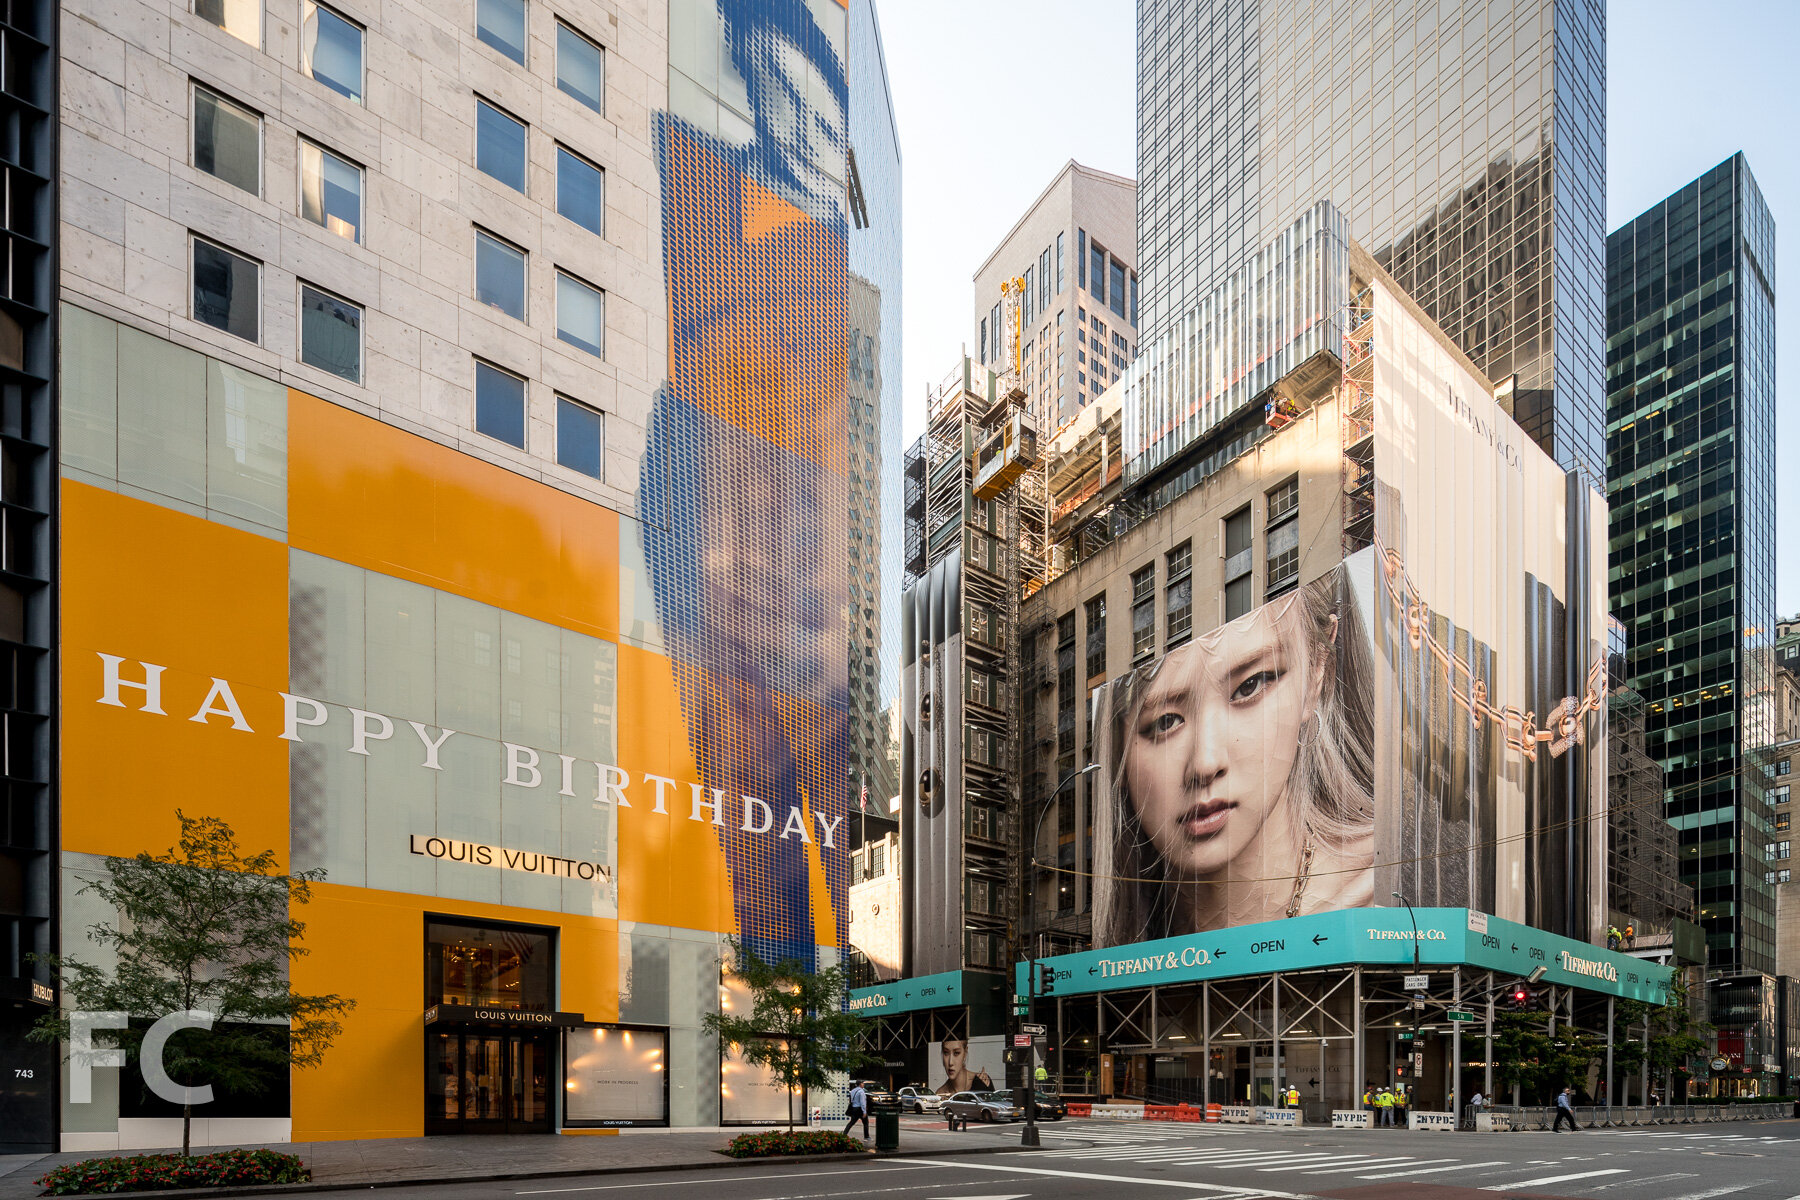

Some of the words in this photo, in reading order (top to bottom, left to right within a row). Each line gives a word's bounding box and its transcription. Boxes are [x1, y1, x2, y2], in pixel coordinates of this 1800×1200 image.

[96, 651, 457, 771] HAPPY
[502, 741, 843, 849] BIRTHDAY
[410, 834, 492, 865] LOUIS
[503, 849, 611, 884] VUITTON
[1367, 928, 1416, 940] TIFFANY
[1250, 939, 1285, 955] OPEN
[1482, 934, 1500, 950] OPEN
[1529, 947, 1545, 961] OPEN
[1098, 955, 1165, 978] TIFFANY
[1561, 950, 1597, 977] TIFFANY
[1051, 969, 1072, 981] OPEN
[1626, 972, 1639, 984] OPEN
[33, 983, 54, 1002] HUBLOT
[921, 987, 936, 997] OPEN
[475, 1010, 506, 1020] LOUIS
[508, 1012, 552, 1023] VUITTON
[14, 1069, 34, 1079] 743
[1224, 1106, 1245, 1117] NYPD
[1269, 1112, 1291, 1120] NYPD
[1337, 1114, 1362, 1122] NYPD
[1420, 1114, 1449, 1125] NYPD
